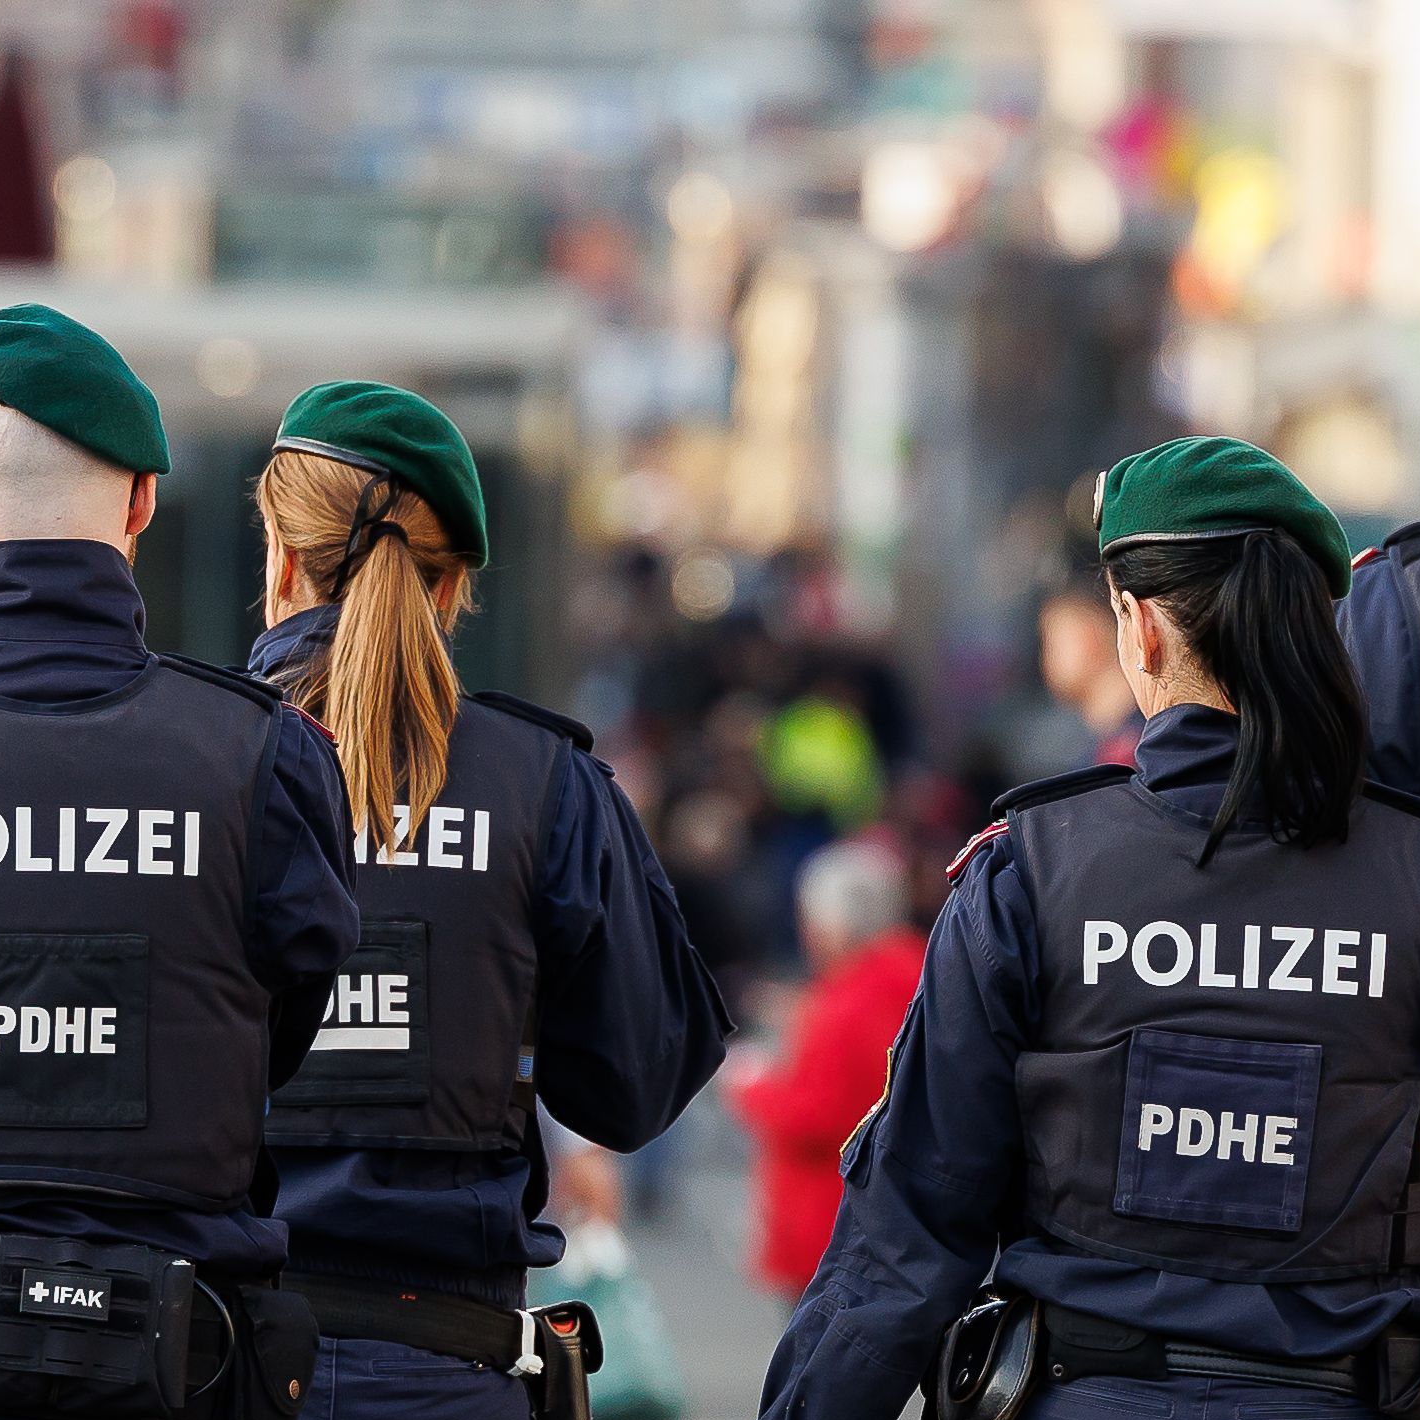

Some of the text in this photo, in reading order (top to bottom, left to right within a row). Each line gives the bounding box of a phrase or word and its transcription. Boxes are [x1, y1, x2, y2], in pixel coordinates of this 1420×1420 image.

[1082, 920, 1387, 998] POLIZEI
[322, 974, 410, 1023] HE
[1137, 1103, 1298, 1166] PDHE
[53, 1285, 104, 1309] IFAK
